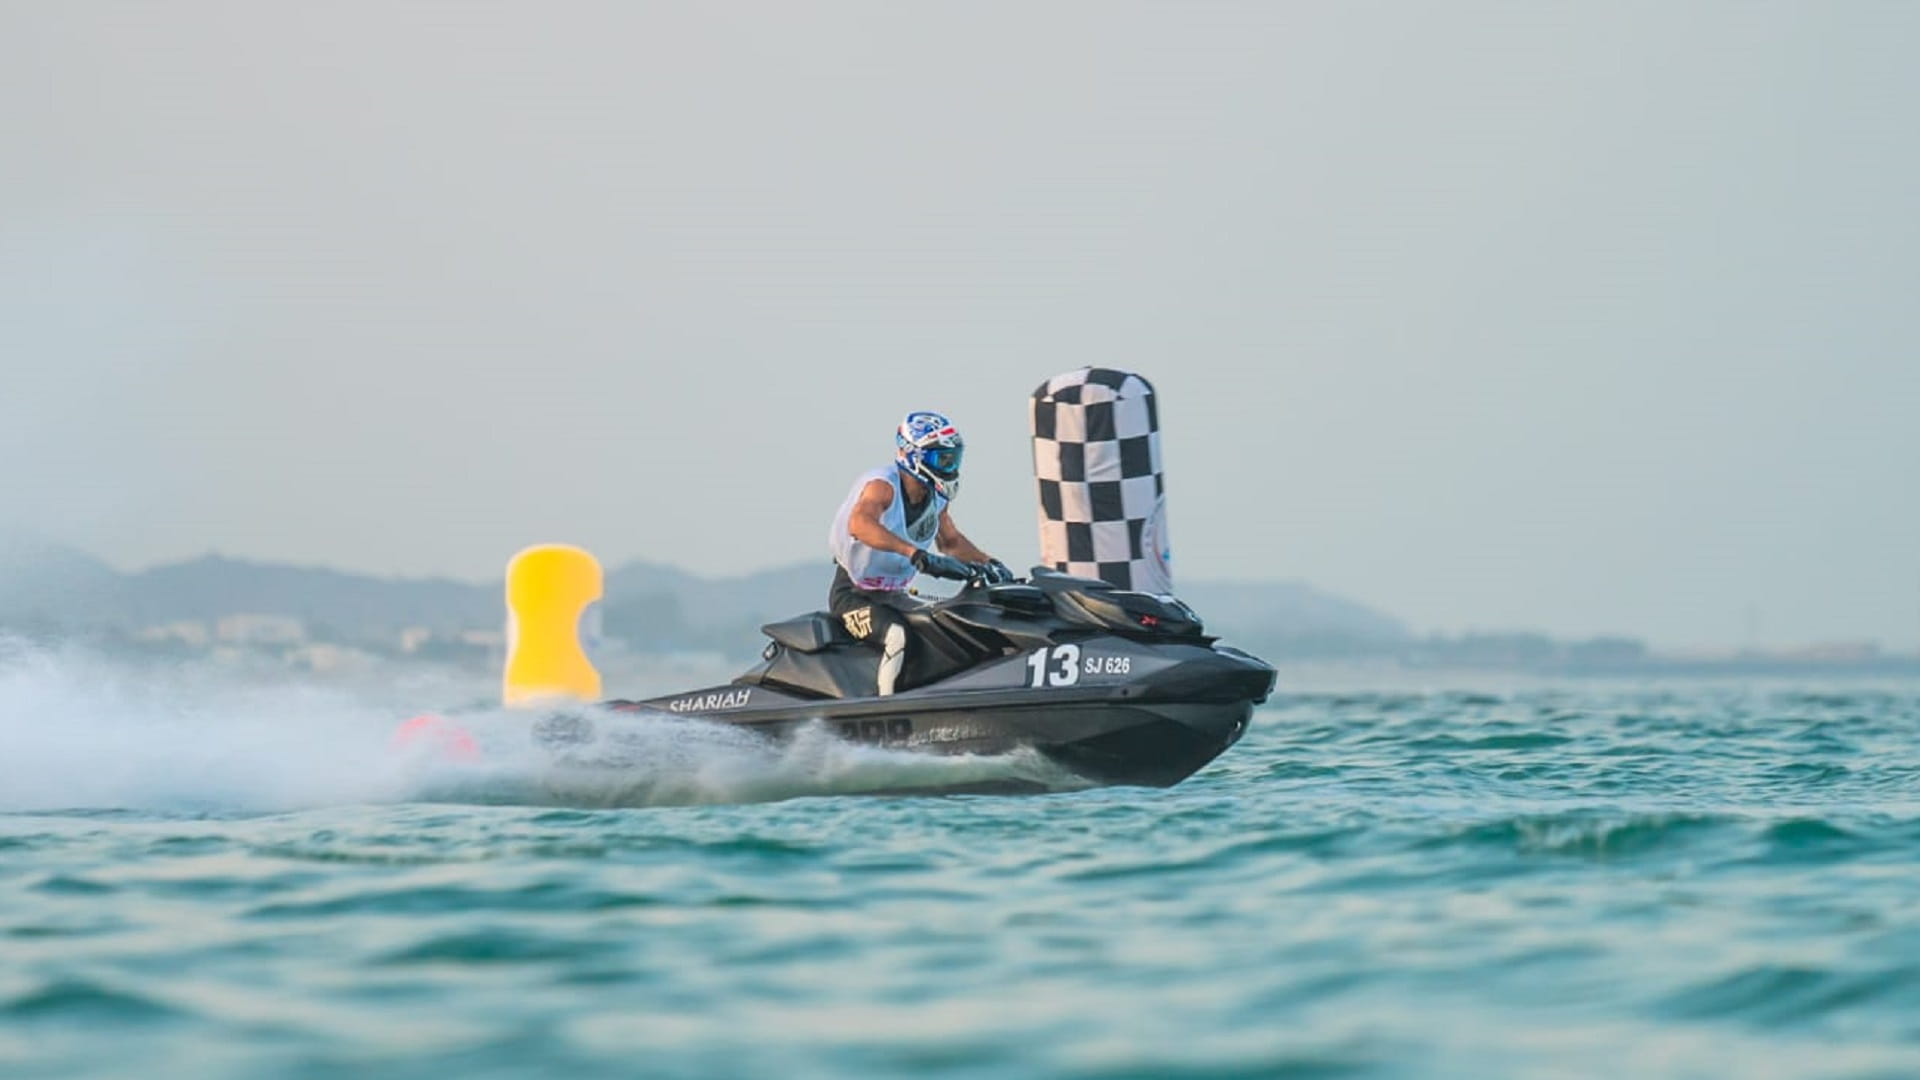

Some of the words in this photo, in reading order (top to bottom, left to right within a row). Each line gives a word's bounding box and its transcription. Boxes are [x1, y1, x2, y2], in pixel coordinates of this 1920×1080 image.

[1027, 643, 1080, 688] 13
[1085, 657, 1103, 674] SJ
[1105, 657, 1131, 674] 626
